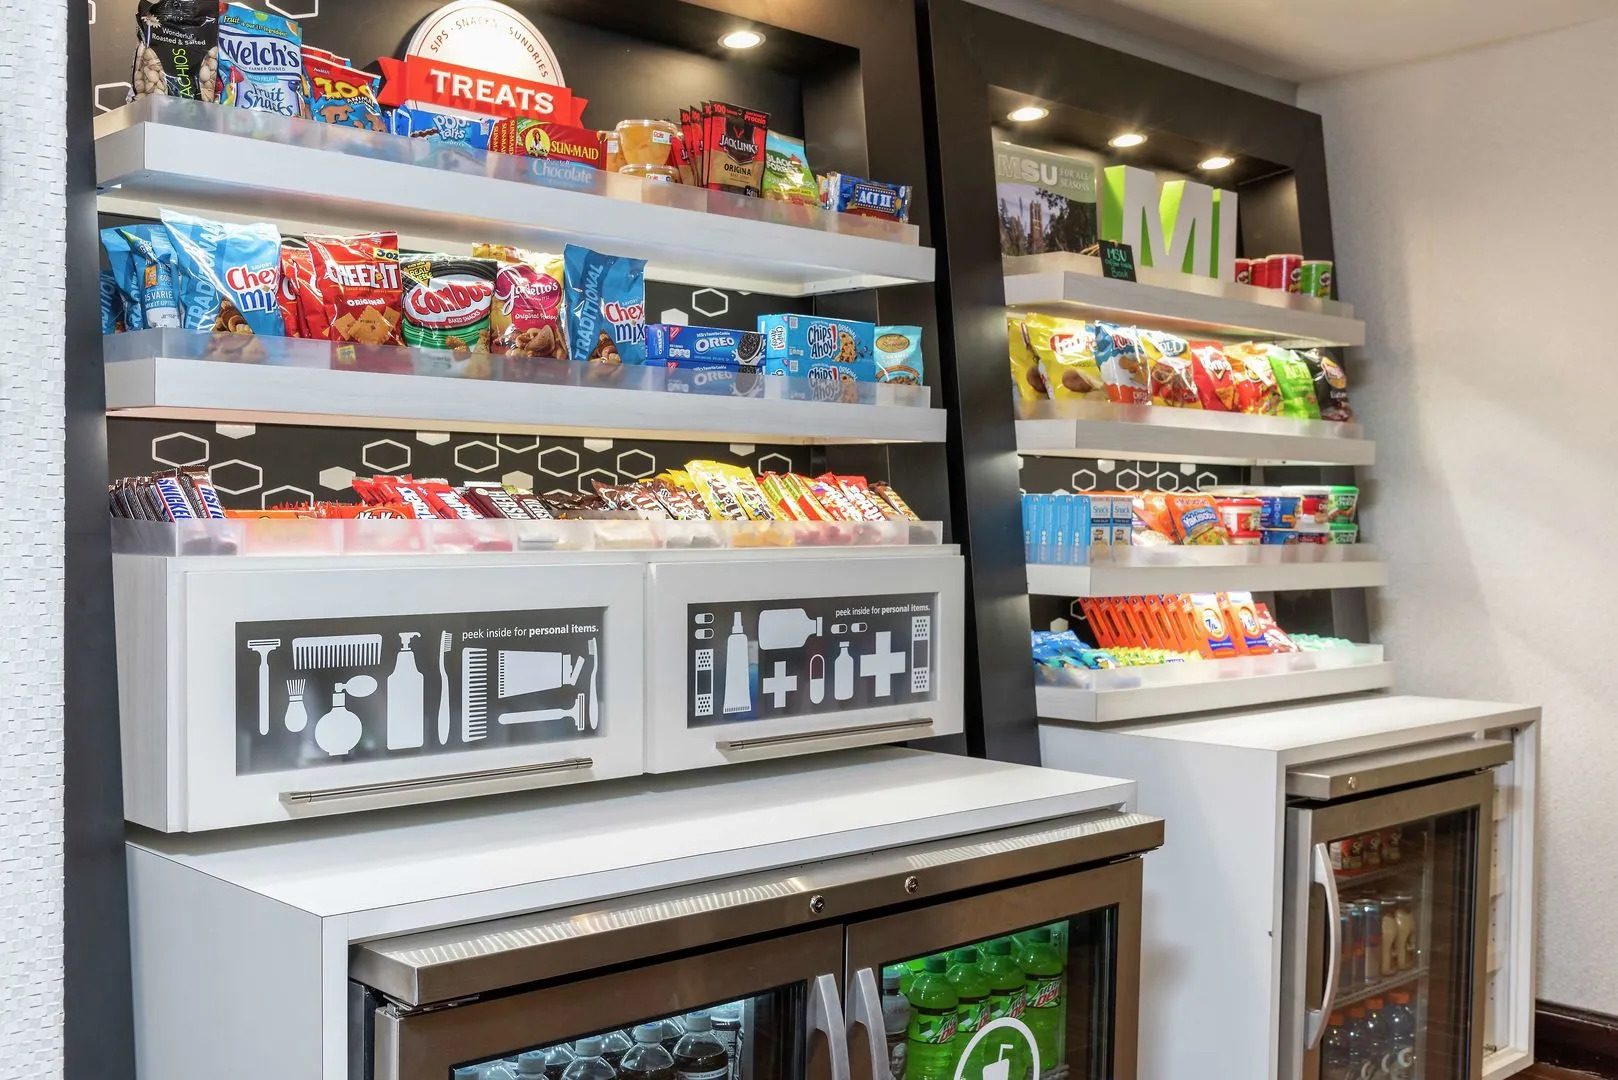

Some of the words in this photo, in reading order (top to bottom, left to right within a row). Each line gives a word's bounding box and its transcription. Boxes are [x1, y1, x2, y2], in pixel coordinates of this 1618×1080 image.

[223, 15, 240, 24] Fruit
[152, 33, 177, 44] Roasted
[218, 37, 300, 67] Welch's
[430, 30, 450, 53] SIPS
[508, 26, 550, 78] SUNDRIES
[252, 83, 284, 102] Fruit
[430, 68, 554, 114] TREATS
[713, 103, 726, 114] 100
[719, 135, 737, 151] JACK
[766, 153, 793, 167] BLACK
[532, 159, 593, 184] Chocolate
[997, 154, 1058, 186] MSU
[1075, 170, 1089, 180] ALL
[1061, 179, 1090, 191] SEASONS
[858, 190, 879, 205] ACT
[880, 194, 892, 208] II
[1107, 247, 1127, 262] MSU
[409, 267, 429, 277] REAL
[463, 310, 481, 322] SNACKS
[514, 313, 540, 321] Original
[574, 263, 605, 361] TRADITIONAL
[603, 302, 645, 323] Chex
[615, 323, 645, 344] mix
[694, 336, 735, 353] OREO
[693, 371, 733, 386] OREO
[835, 608, 851, 618] peek
[852, 606, 870, 616] inside
[871, 605, 880, 614] for
[881, 604, 910, 616] personal
[911, 603, 931, 612] items.
[462, 628, 484, 641] peek
[486, 627, 512, 639] inside
[514, 626, 528, 637] for
[529, 624, 569, 638] personal
[571, 623, 599, 634] items.
